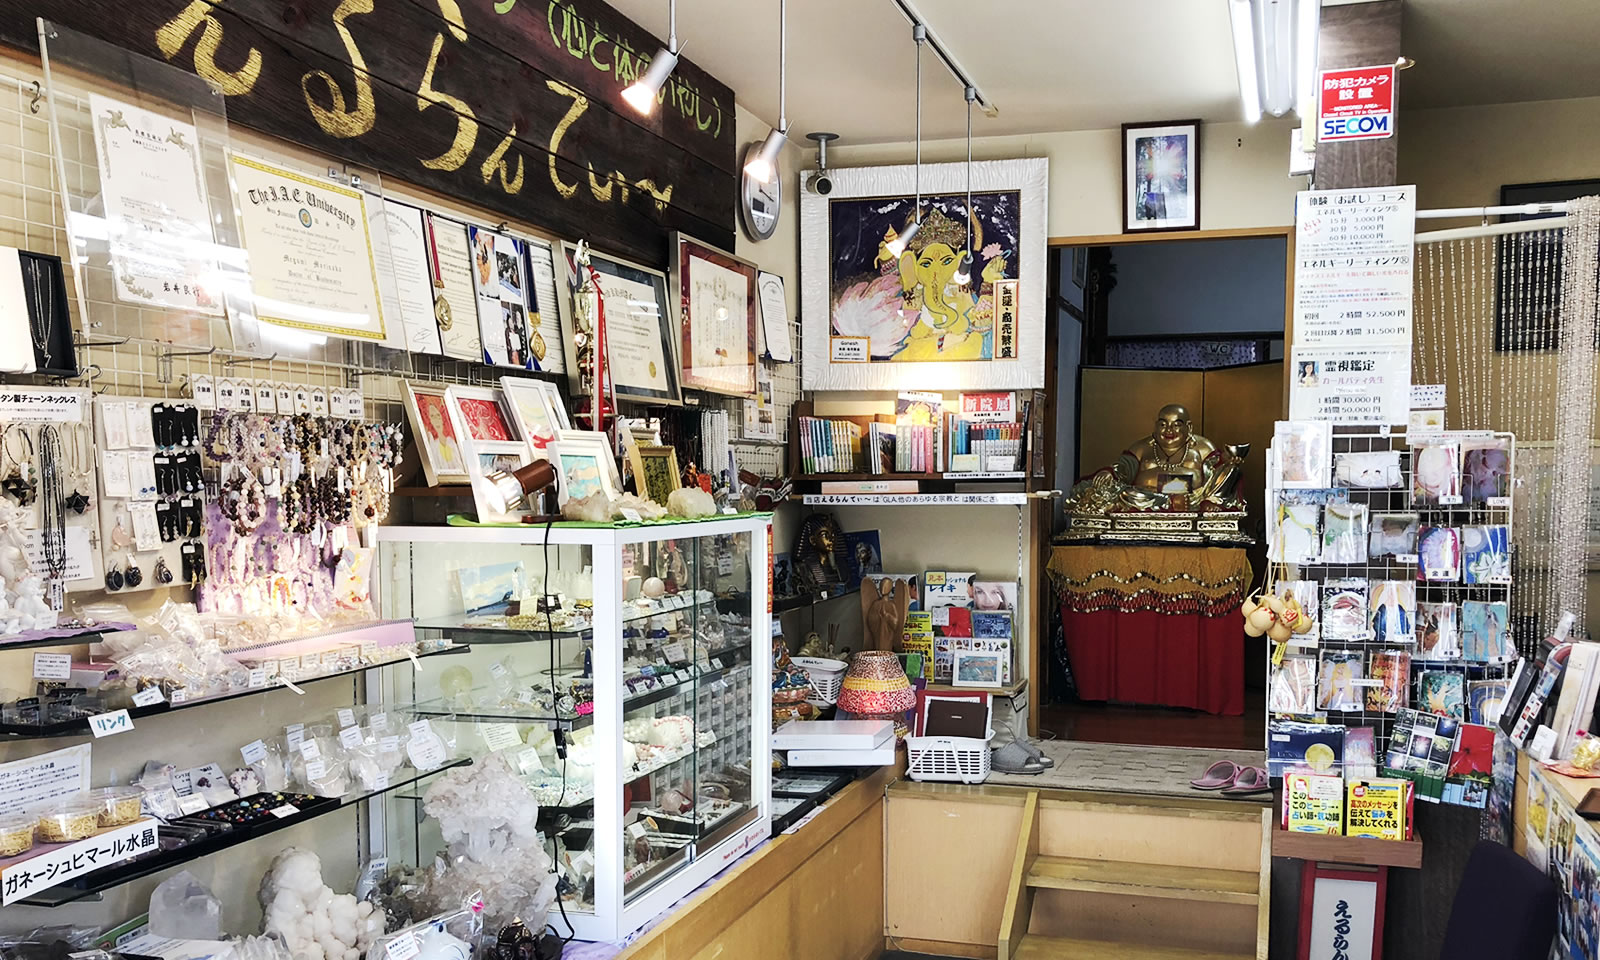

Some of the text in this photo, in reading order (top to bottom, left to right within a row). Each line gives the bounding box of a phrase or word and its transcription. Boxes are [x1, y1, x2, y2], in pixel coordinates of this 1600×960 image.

[1324, 75, 1389, 90] 防犯カメラ
[1339, 87, 1373, 101] 設置
[1324, 116, 1387, 135] SECOM
[305, 190, 356, 230] University
[1325, 359, 1375, 372] 霊視鑑定
[965, 397, 1009, 411] 新院展
[929, 584, 956, 593] レイキ
[97, 715, 125, 731] リング
[1350, 799, 1398, 810] 高次のメッセージを
[1350, 809, 1393, 819] 伝えて悩みを
[1350, 818, 1398, 828] 解決してくれる
[5, 828, 155, 896] ガネーシュヒマール水晶
